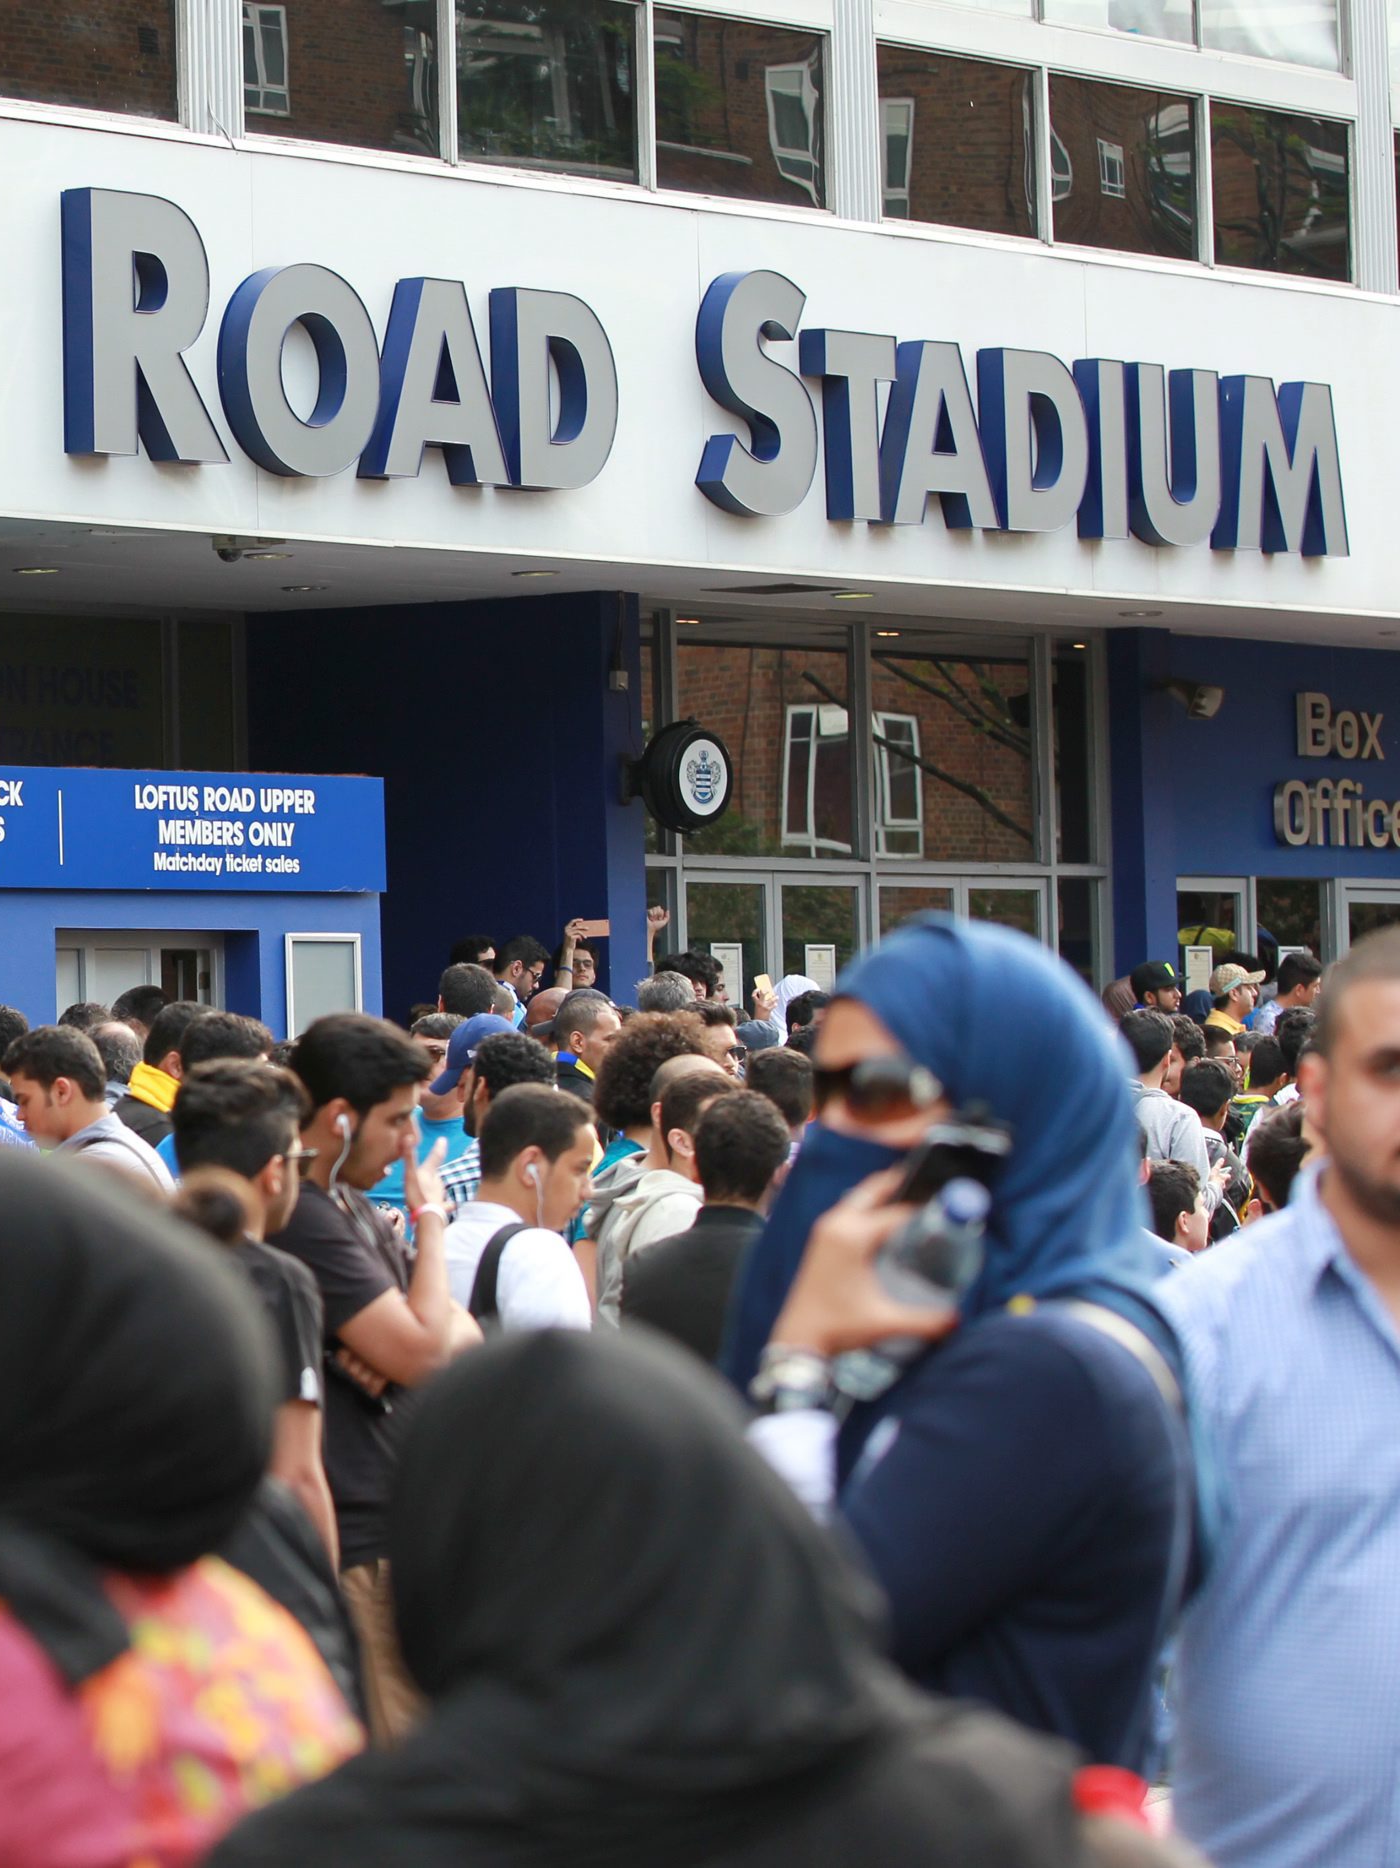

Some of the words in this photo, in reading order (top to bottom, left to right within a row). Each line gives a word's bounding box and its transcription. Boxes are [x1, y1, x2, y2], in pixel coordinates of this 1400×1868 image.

[134, 784, 199, 811] LOFTUS
[203, 786, 256, 813] ROAD
[260, 788, 316, 814] UPPER
[158, 819, 244, 846] MEMBERS
[249, 821, 295, 847] ONLY
[153, 851, 223, 876] Matchday
[225, 853, 263, 873] ticket
[265, 854, 301, 874] sales
